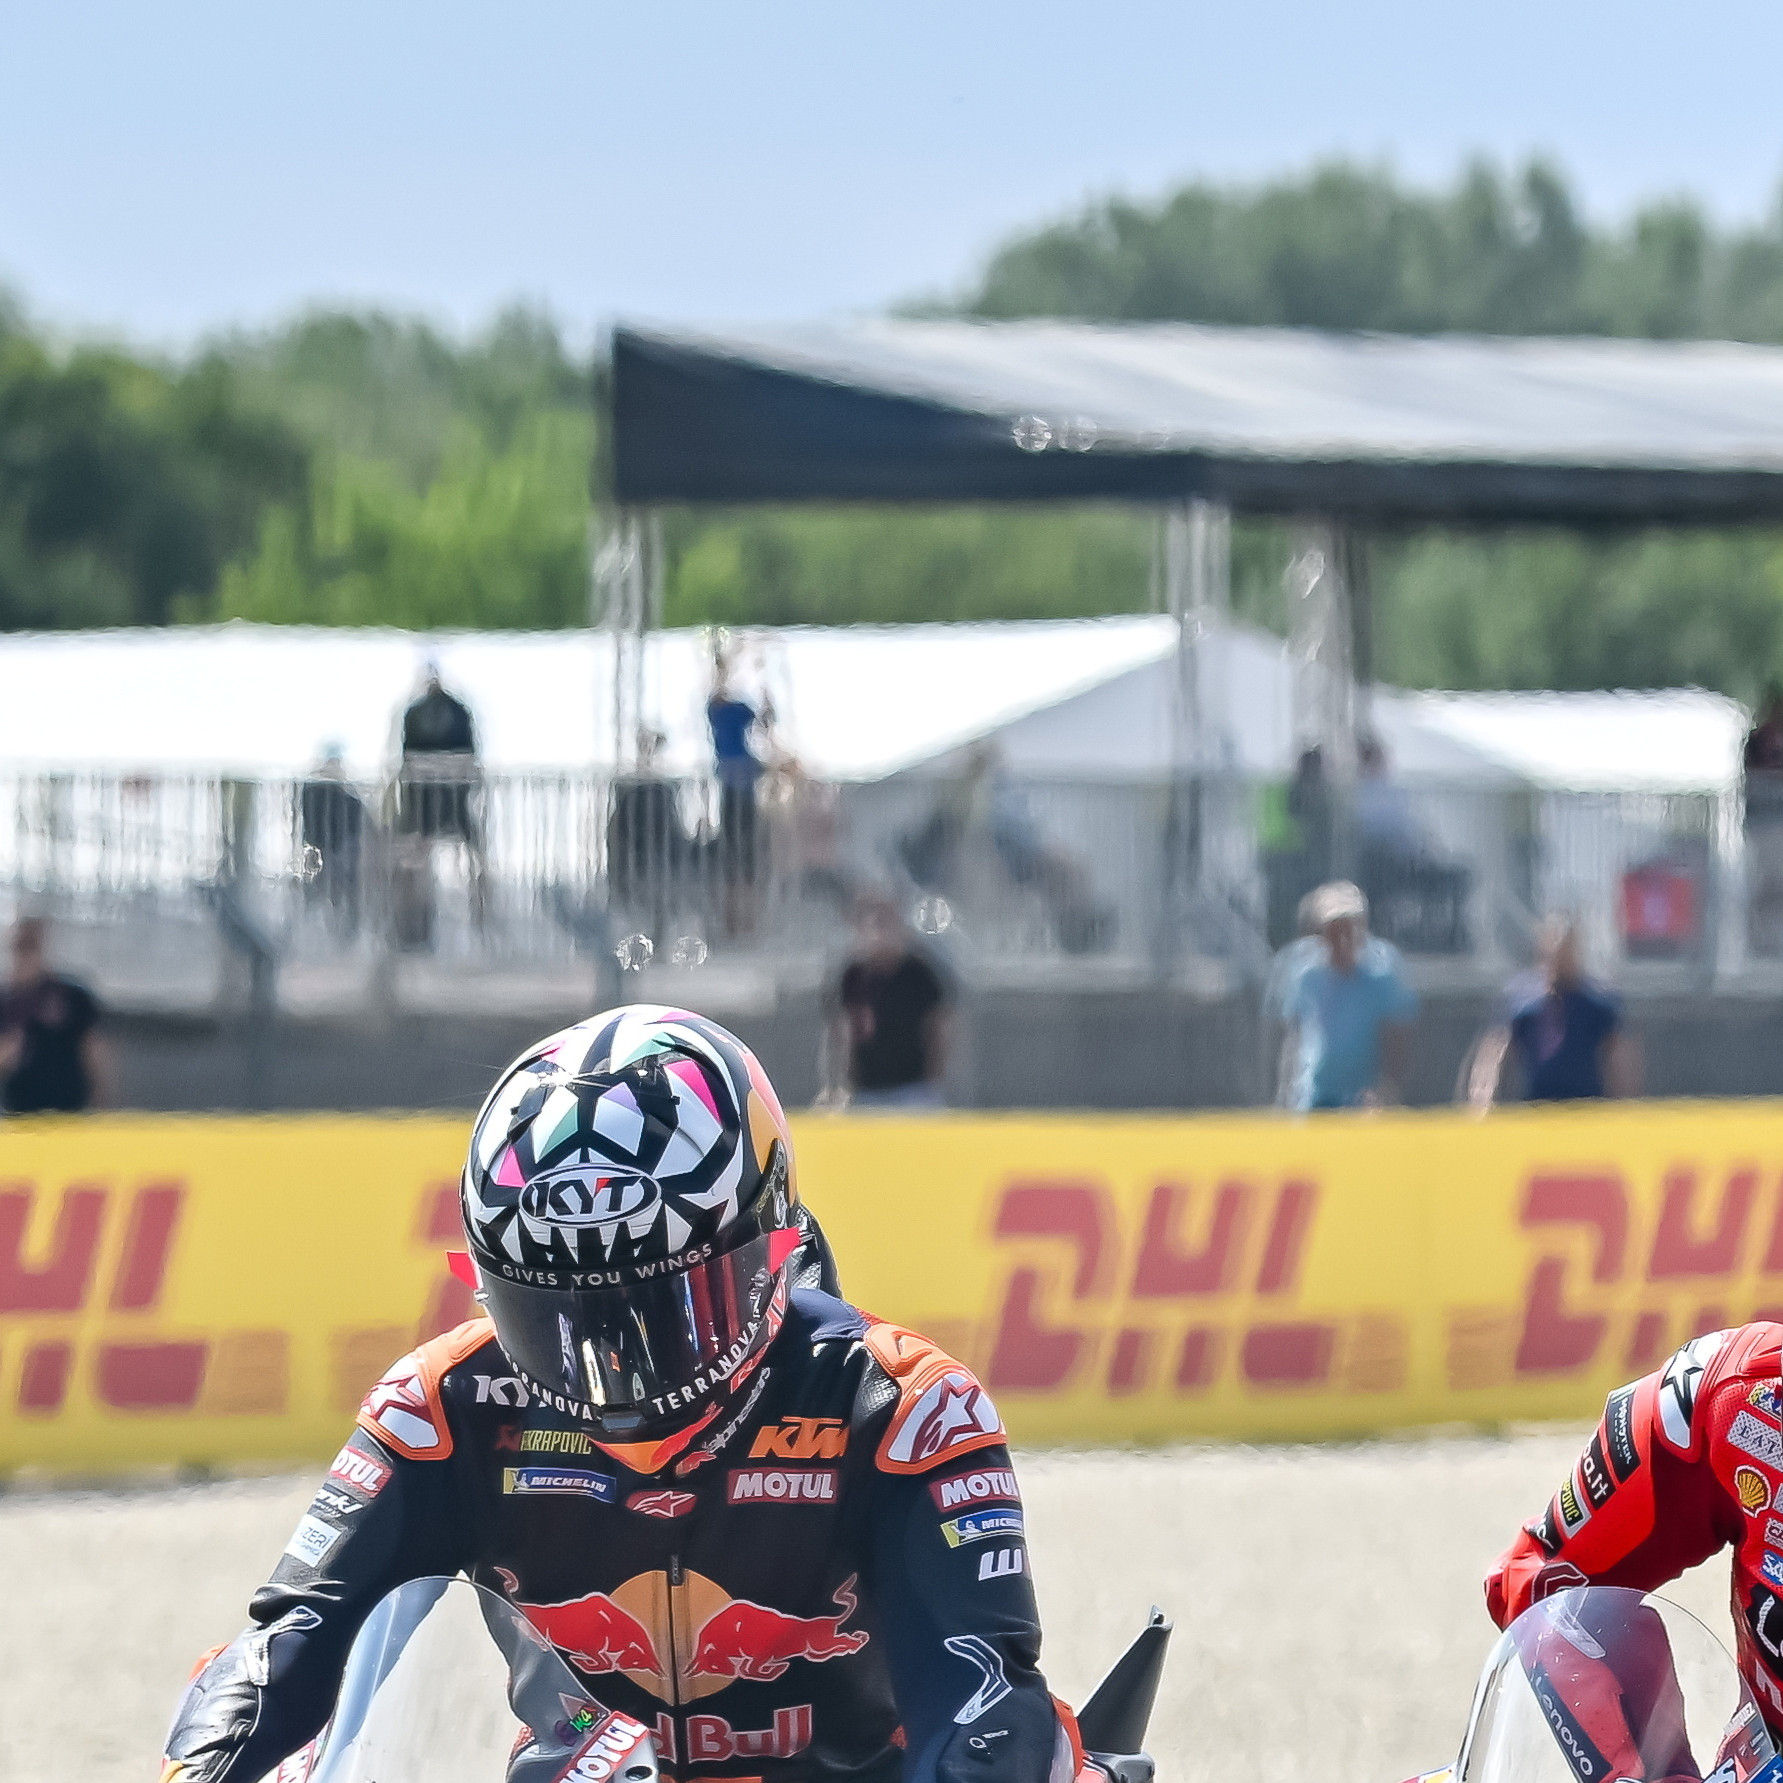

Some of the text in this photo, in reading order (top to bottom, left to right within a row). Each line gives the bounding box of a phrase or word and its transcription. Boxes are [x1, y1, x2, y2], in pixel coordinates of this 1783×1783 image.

[533, 1176, 643, 1218] KYT
[502, 1243, 713, 1287] GIVES YOU WINGS
[986, 1174, 1333, 1392] DHL
[651, 1320, 761, 1416] TERRANOVA
[748, 1416, 849, 1459] KTM
[530, 1476, 608, 1493] MICHELIN
[732, 1472, 834, 1500] MOTUL
